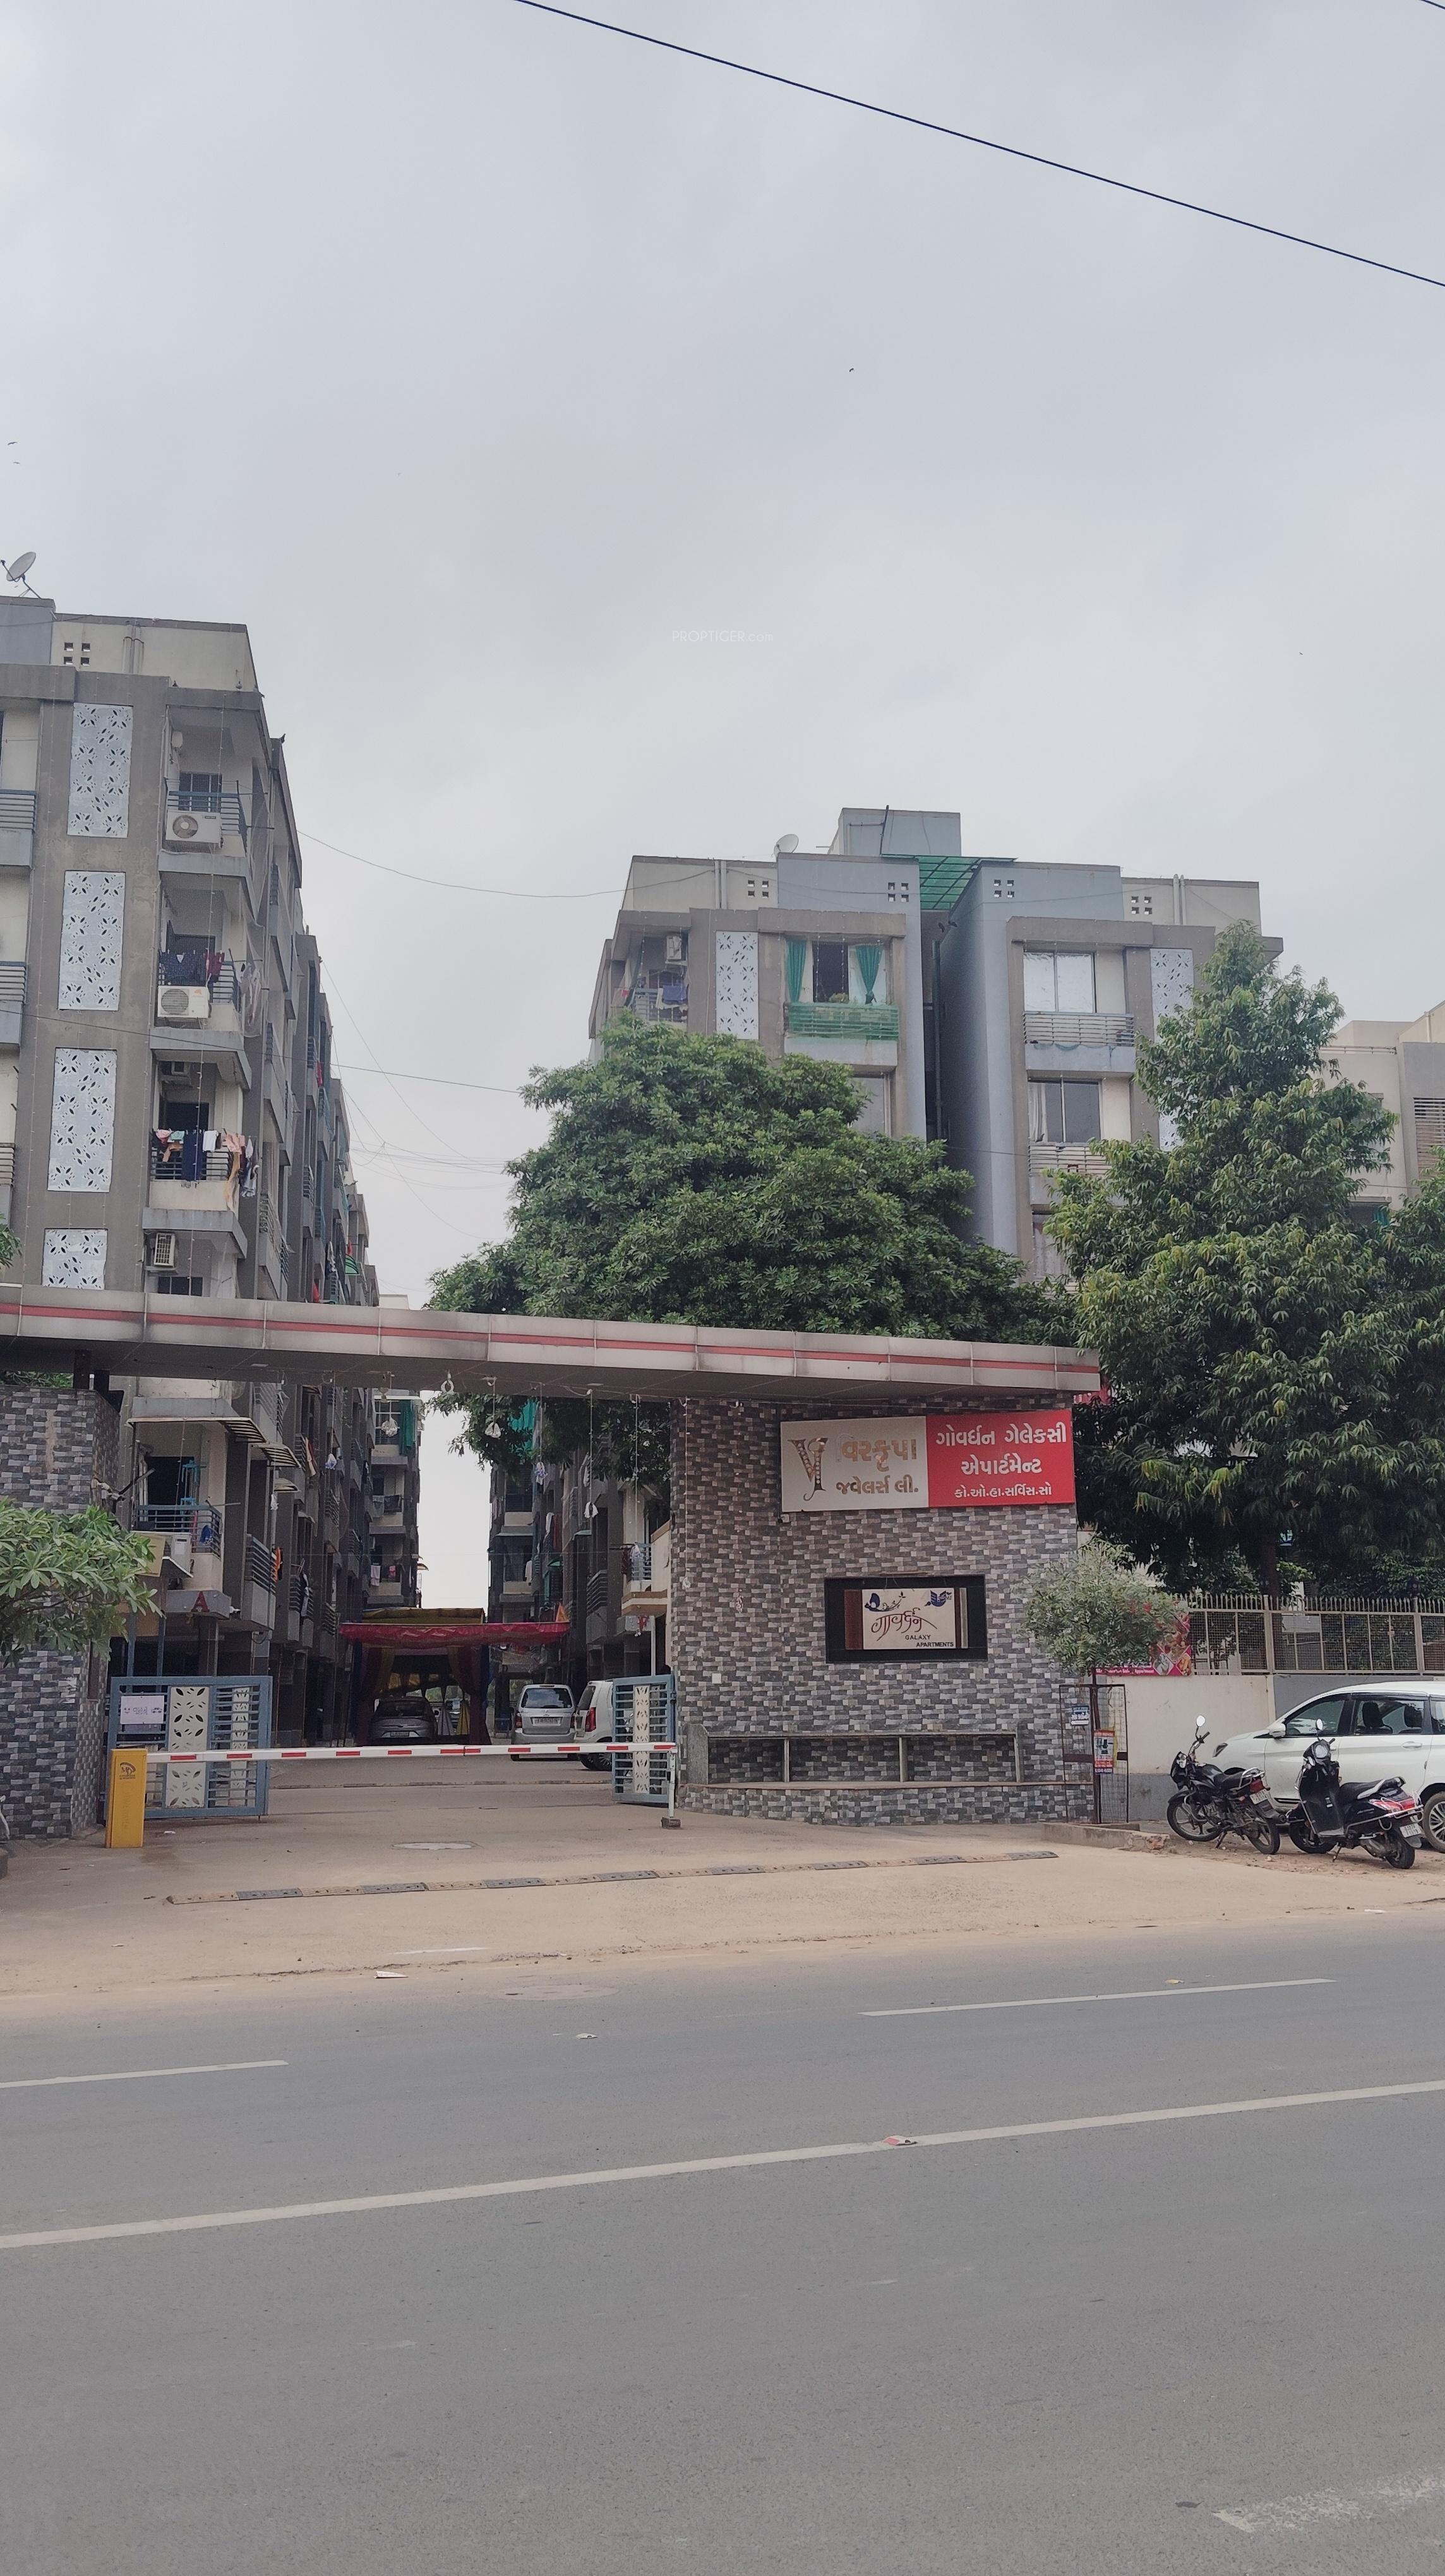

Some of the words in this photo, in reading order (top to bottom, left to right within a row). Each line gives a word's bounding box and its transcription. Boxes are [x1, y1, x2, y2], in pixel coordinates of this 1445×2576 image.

[935, 1424, 996, 1446] ગોવર્ધન
[961, 1453, 1043, 1476] એપાર્ટમેન્ટ
[894, 1474, 919, 1493] લી.
[191, 1590, 210, 1613] A
